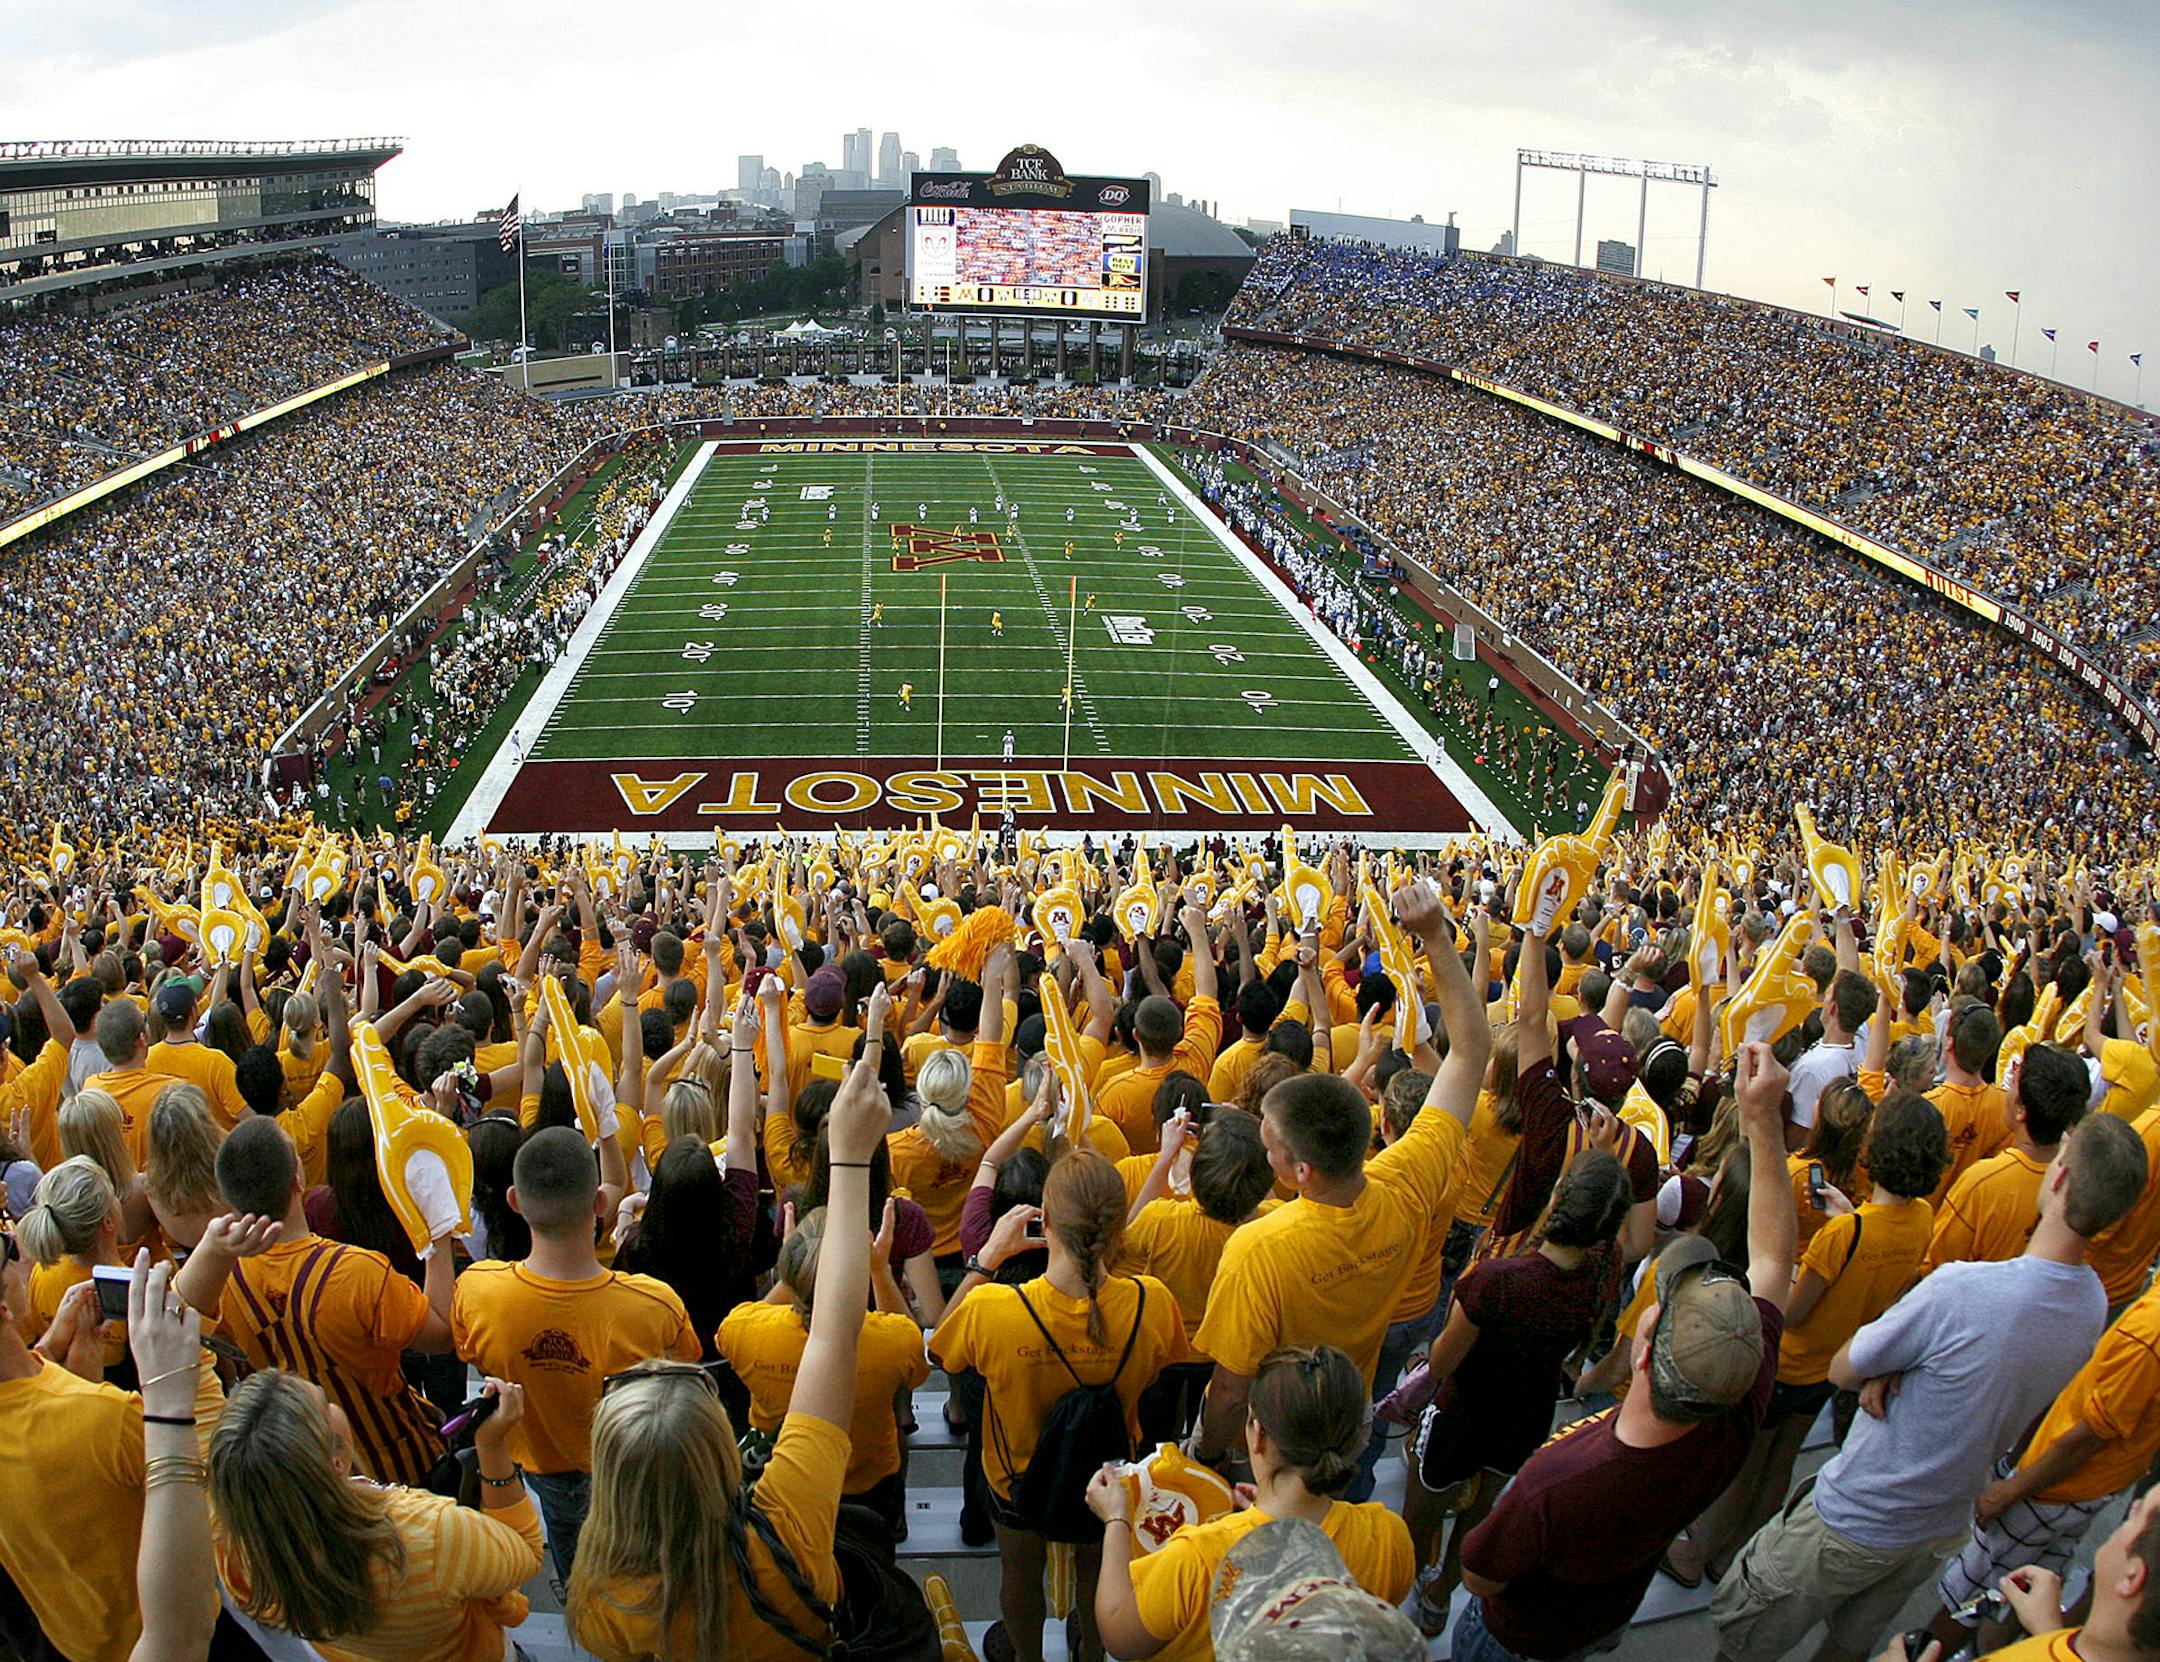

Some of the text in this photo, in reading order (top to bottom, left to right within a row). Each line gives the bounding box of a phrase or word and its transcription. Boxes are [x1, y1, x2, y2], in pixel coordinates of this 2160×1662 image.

[1016, 157, 1044, 170] TCF
[1010, 168, 1049, 181] BANK
[919, 180, 973, 199] Coca-Cola
[1104, 190, 1125, 203] DQ
[1104, 215, 1142, 225] GOPHER
[758, 442, 1097, 456] MINNESOTA
[698, 602, 729, 618] 30
[1180, 605, 1215, 621] 30
[2004, 611, 2026, 635] 1900
[2030, 628, 2054, 653] 1903
[681, 640, 716, 660] 20
[1208, 643, 1246, 662] 20
[661, 690, 699, 709] 10
[1240, 690, 1280, 708] 10
[610, 770, 1374, 815] MINNESOTA
[1311, 1271, 1335, 1285] Get
[1016, 1345, 1041, 1357] Get
